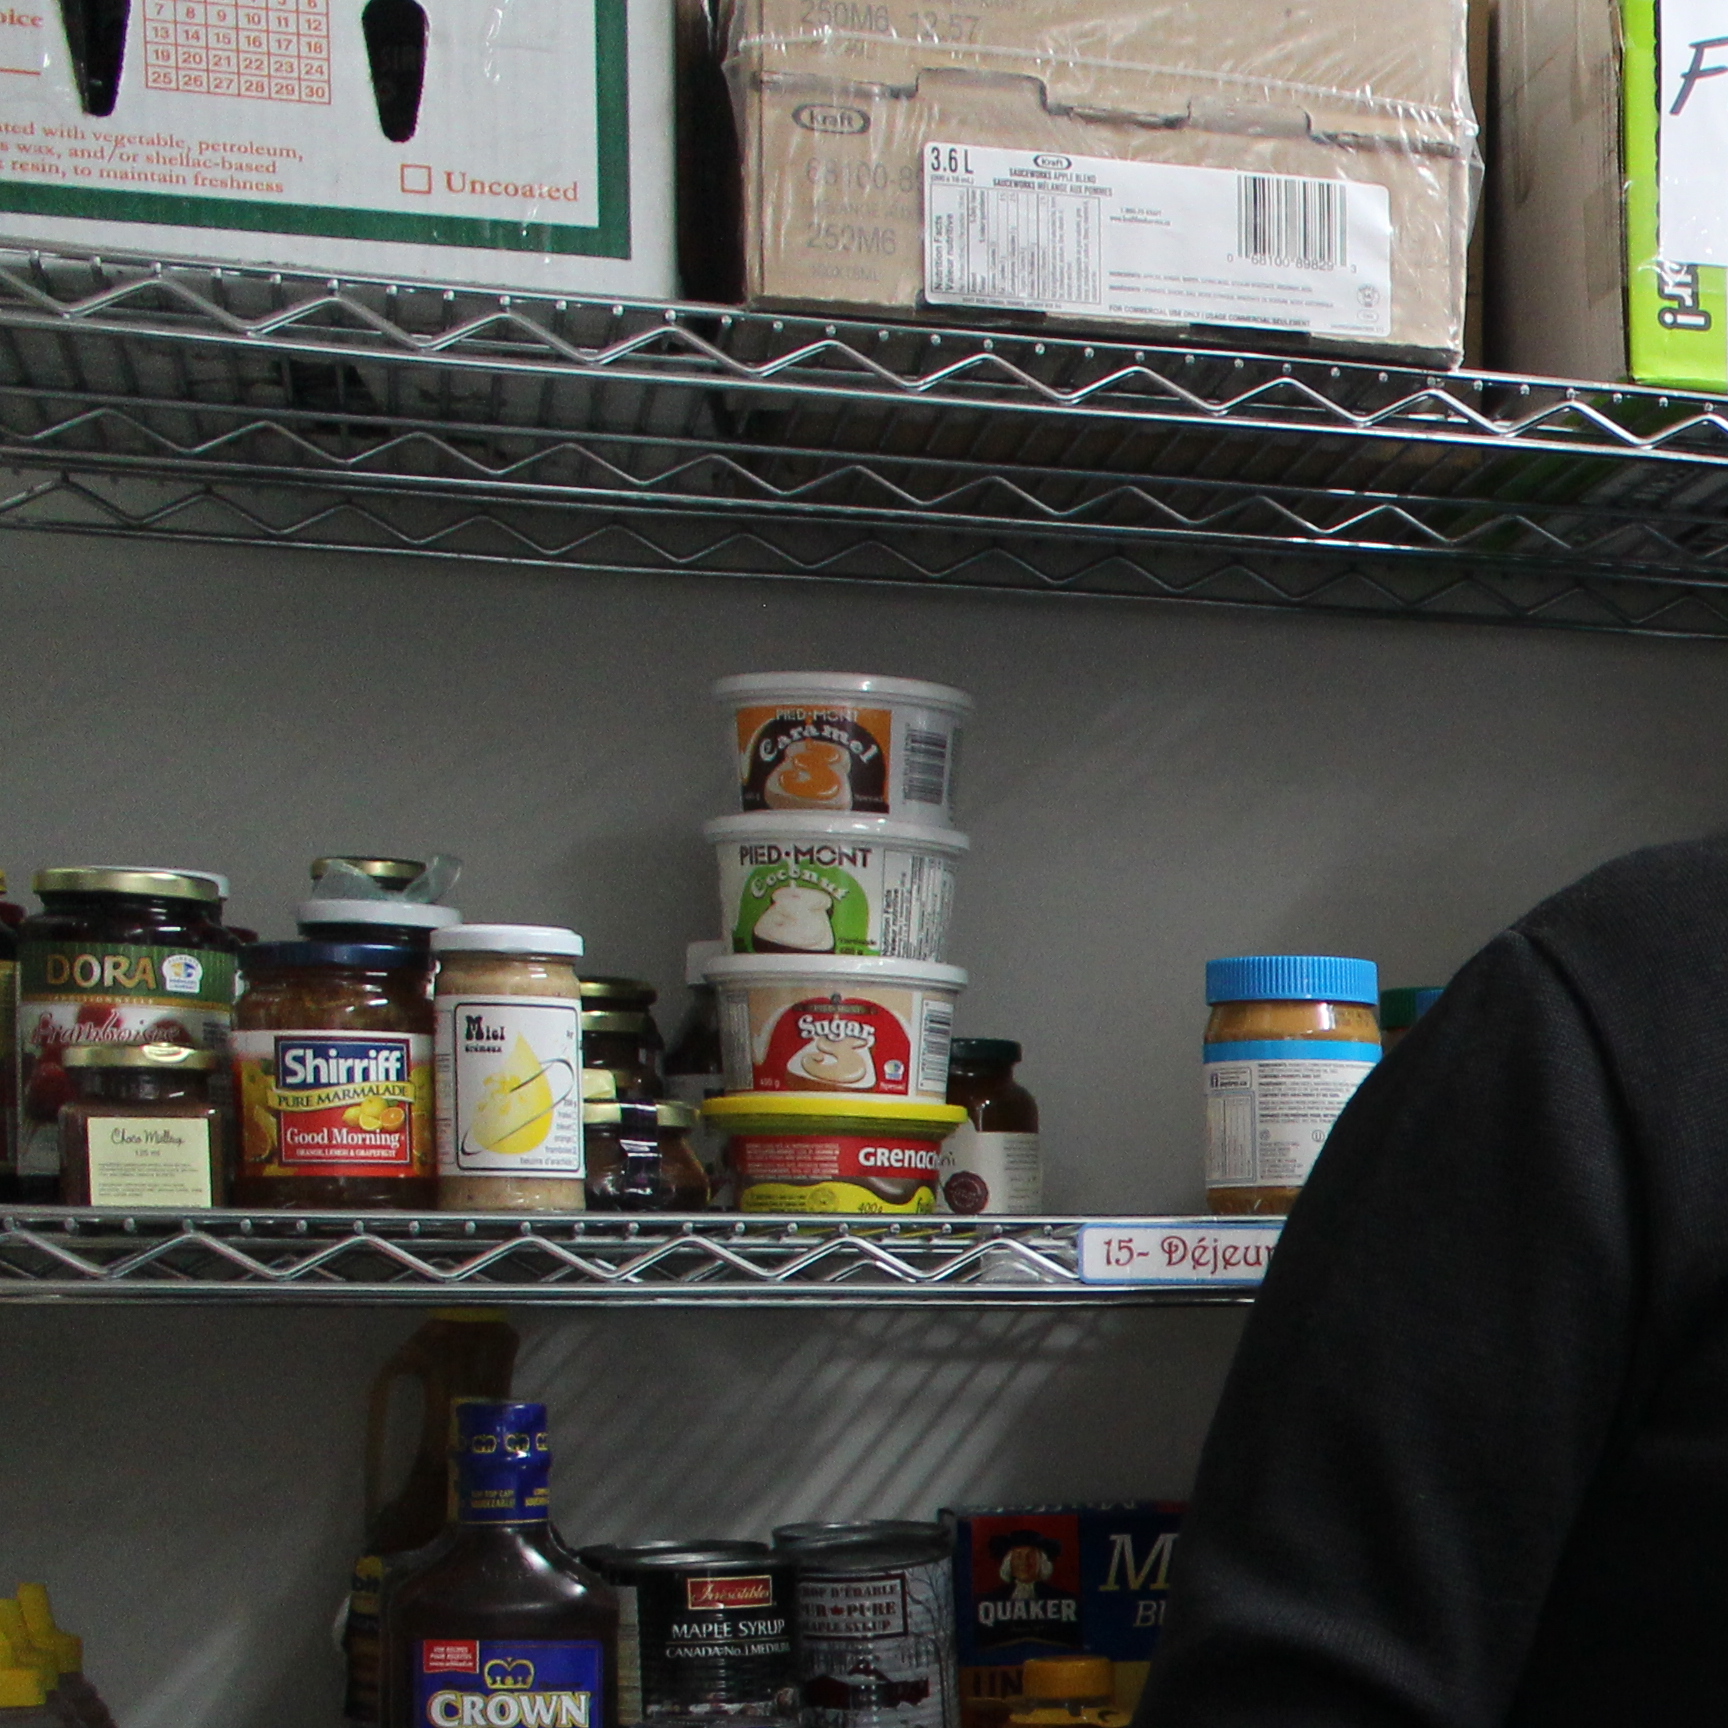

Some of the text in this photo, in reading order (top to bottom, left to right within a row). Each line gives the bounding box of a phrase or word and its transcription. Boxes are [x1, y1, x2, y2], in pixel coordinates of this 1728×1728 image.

[931, 147, 974, 174] 3.6 L
[444, 170, 579, 202] Uncoated
[759, 725, 879, 764] Caramel
[751, 865, 849, 901] Coconut
[46, 954, 156, 990] DORA
[798, 1014, 876, 1045] Sugar
[284, 1048, 403, 1085] Shirriff
[277, 1083, 408, 1108] PURE MARMALADE
[286, 1127, 400, 1150] Good Morning
[1103, 1236, 1151, 1268] 15-
[671, 1618, 785, 1639] MAPLE SYRUP
[977, 1600, 1077, 1625] QUAKER
[428, 1691, 590, 1728] CROWN
